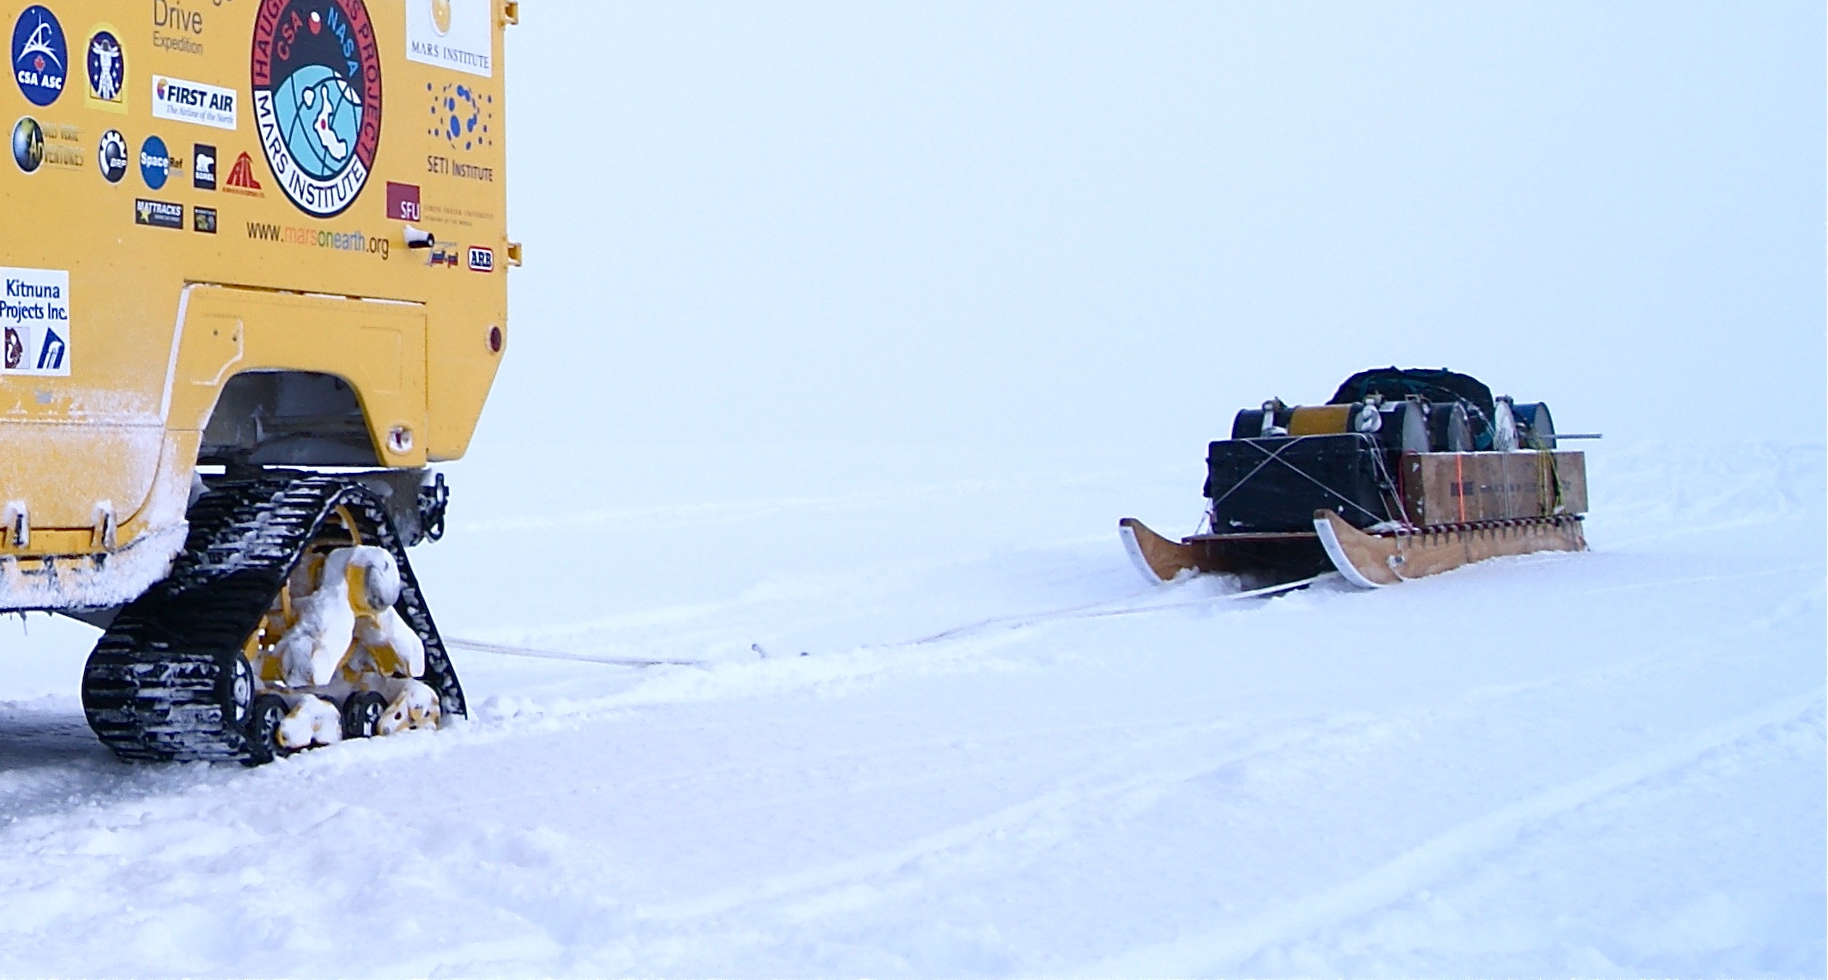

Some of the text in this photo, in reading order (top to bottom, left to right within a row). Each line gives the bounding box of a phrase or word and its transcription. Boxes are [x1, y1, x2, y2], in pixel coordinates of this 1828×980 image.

[153, 31, 203, 55] Expedition
[277, 10, 303, 61] CSA
[327, 6, 360, 77] NASA
[412, 40, 490, 69] MARS INSTITUTE
[18, 70, 62, 90] CSA ASC
[358, 22, 378, 159] PROJECT
[167, 85, 233, 112] FIRST AIR
[258, 95, 363, 208] MARS INSTITUTE
[427, 155, 449, 174] SETI
[137, 200, 182, 217] MATTRACKS
[400, 201, 420, 220] SFU
[246, 222, 389, 260] www.marsonearth.org
[470, 251, 492, 268] ARB
[6, 278, 60, 299] Kitnuna
[0, 300, 68, 323] Projects Inc.
